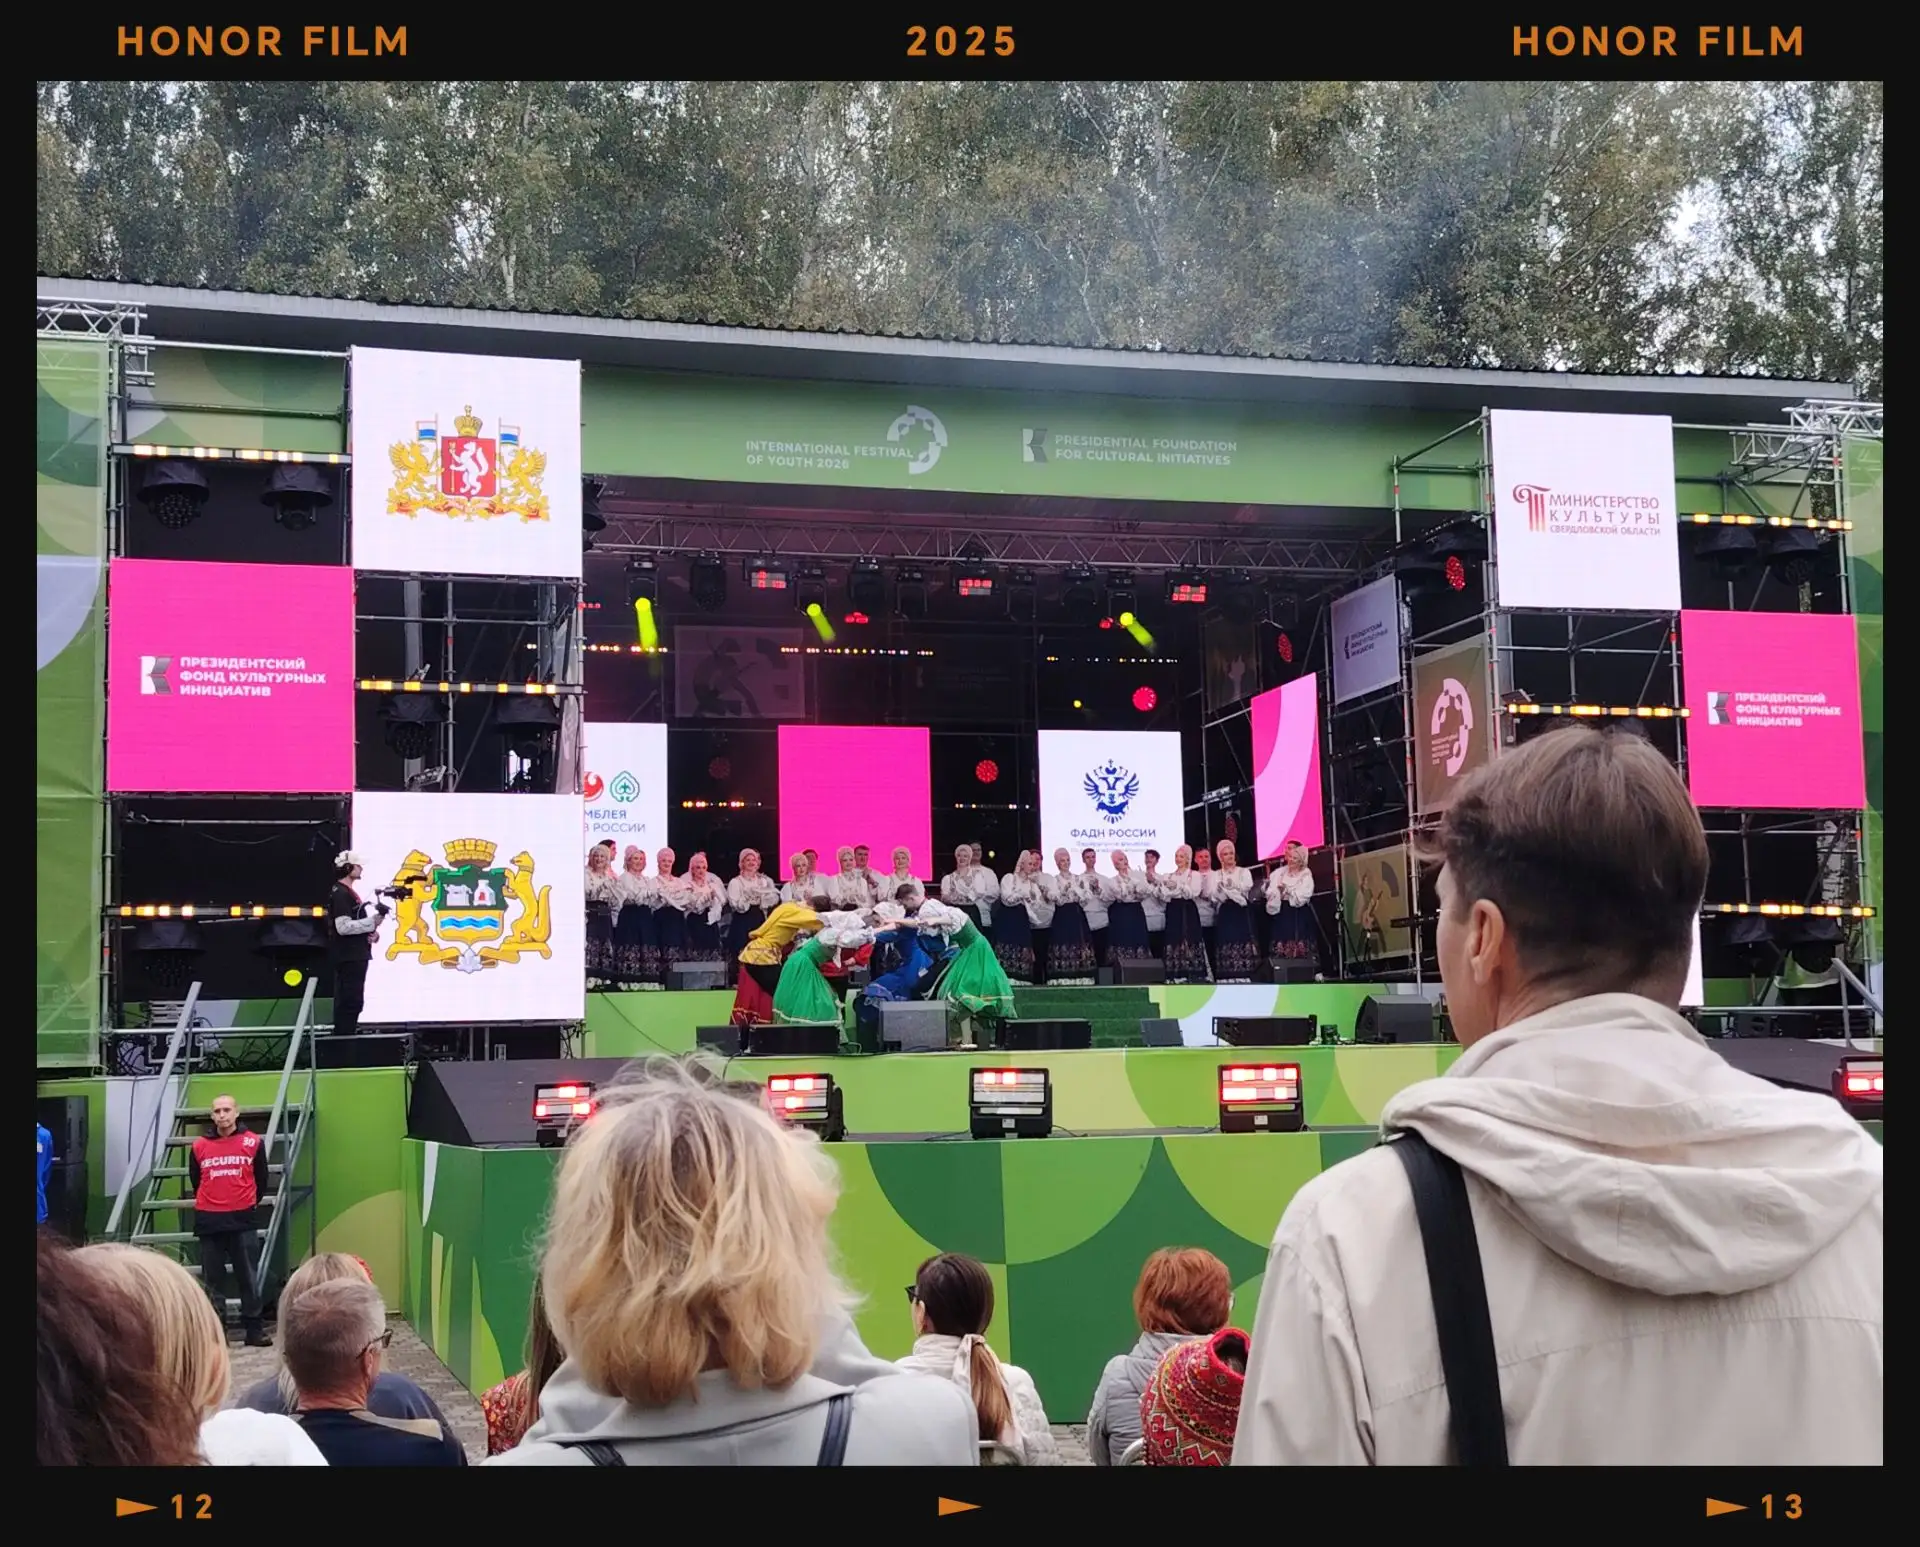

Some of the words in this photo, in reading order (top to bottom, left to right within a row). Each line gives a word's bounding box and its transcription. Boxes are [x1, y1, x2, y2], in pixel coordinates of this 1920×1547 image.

[746, 440, 850, 456] INTERNATIONAL
[854, 445, 914, 458] FESTIVAL
[1055, 434, 1148, 449] PRESIDENTIAL
[1152, 438, 1237, 452] FOUNDATION
[746, 454, 763, 466] OF
[768, 456, 813, 468] YOUTH
[1055, 448, 1082, 460] FOR
[1086, 449, 1153, 463] CULTURAL
[1157, 453, 1231, 466] INITIATIVES
[1549, 493, 1660, 510] МИНИСТЕРСТВО
[1549, 509, 1660, 525] КУЛЬТУРЫ
[1550, 524, 1617, 535] СВЕРДЛОВСКОЙ
[1620, 526, 1661, 536] ОБЛАСТИ
[179, 656, 306, 670] ПРЕЗИДЕНТСКИЙ
[179, 671, 226, 683] ФОНД
[229, 672, 327, 684] КУЛЬТУРНЫХ
[179, 685, 272, 698] ИНИЦИАТИВ
[1735, 692, 1826, 704] ПРЕЗИДЕНТСКИЙ
[1735, 704, 1769, 715] ФОНД
[1771, 705, 1842, 716] КУЛЬТУРНЫХ
[1736, 716, 1804, 727] ИНИЦИАТИВ
[593, 823, 646, 833] РОССИИ
[1070, 828, 1105, 838] ФАДН
[1109, 828, 1156, 838] РОССИИ
